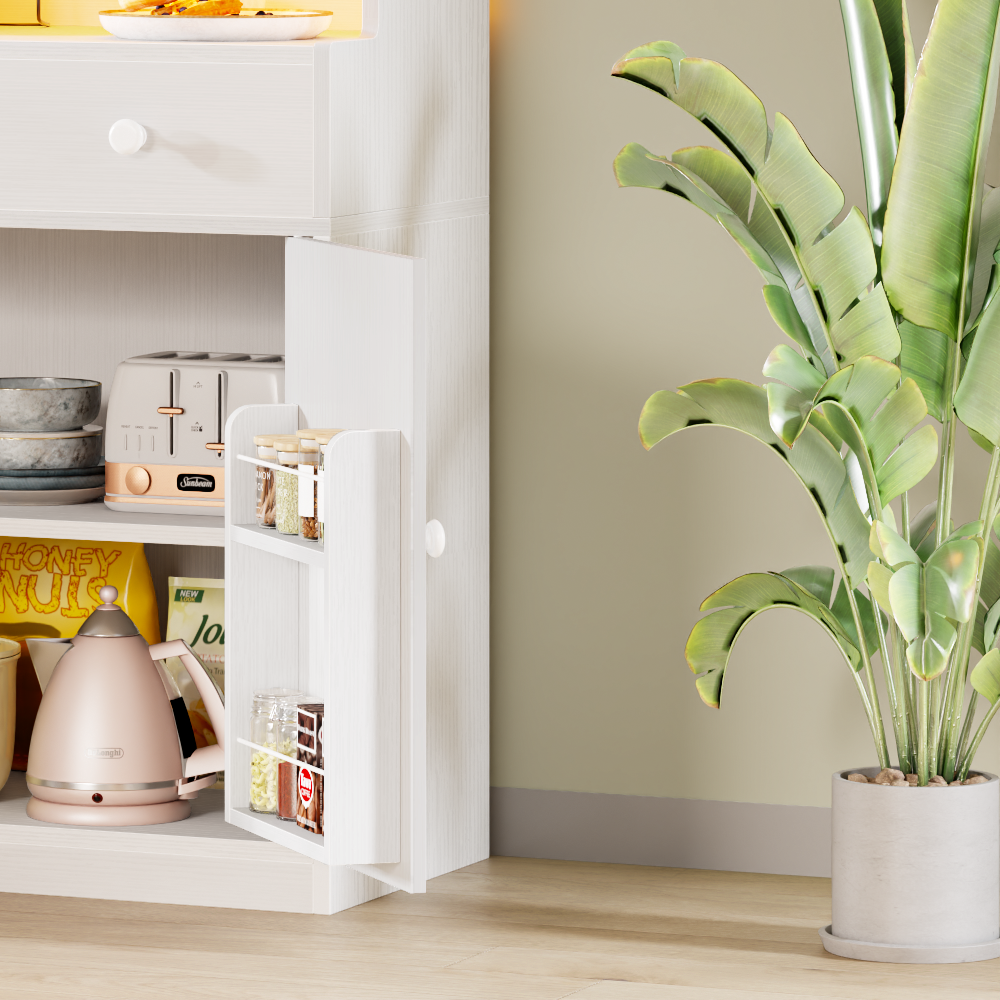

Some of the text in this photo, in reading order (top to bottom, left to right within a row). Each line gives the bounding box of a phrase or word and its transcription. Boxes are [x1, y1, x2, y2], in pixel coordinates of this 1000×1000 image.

[180, 476, 213, 488] Sunbeam
[0, 542, 122, 578] HONEY
[180, 589, 199, 598] NEW
